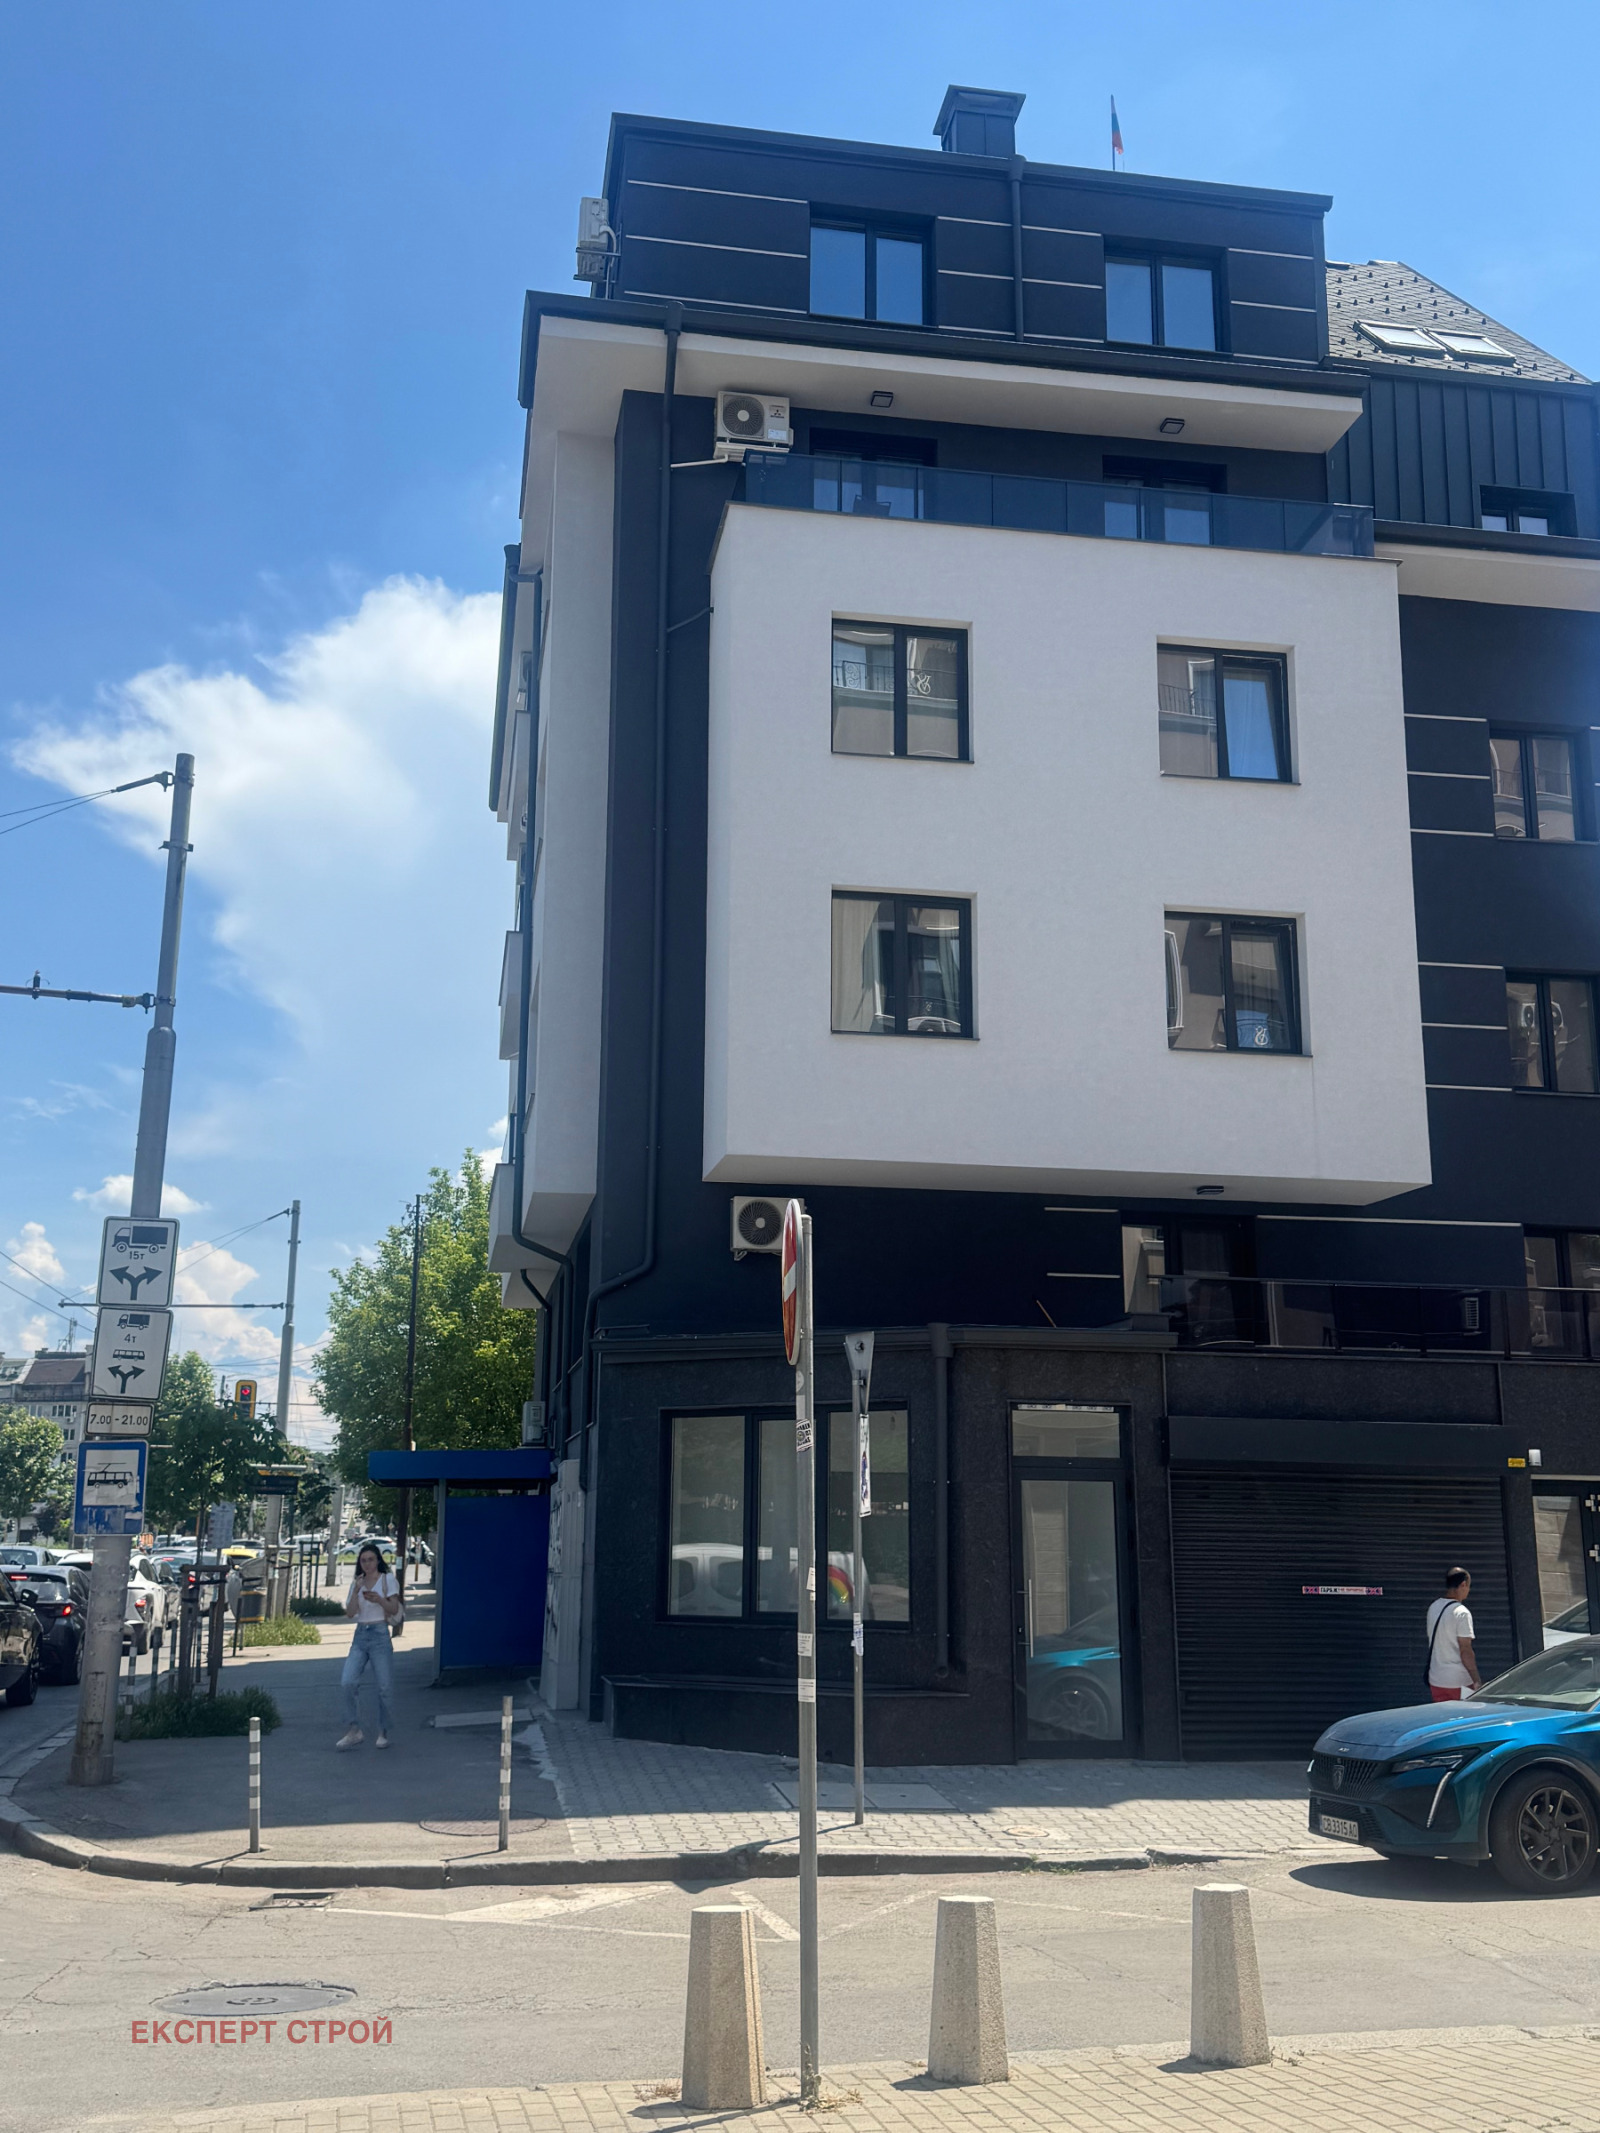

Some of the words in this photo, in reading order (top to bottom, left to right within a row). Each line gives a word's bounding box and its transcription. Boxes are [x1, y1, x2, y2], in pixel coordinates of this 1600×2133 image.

[129, 1251, 145, 1260] 15т
[124, 1333, 137, 1343] 4т
[90, 1414, 111, 1424] 7.00
[121, 1415, 148, 1425] 21.00
